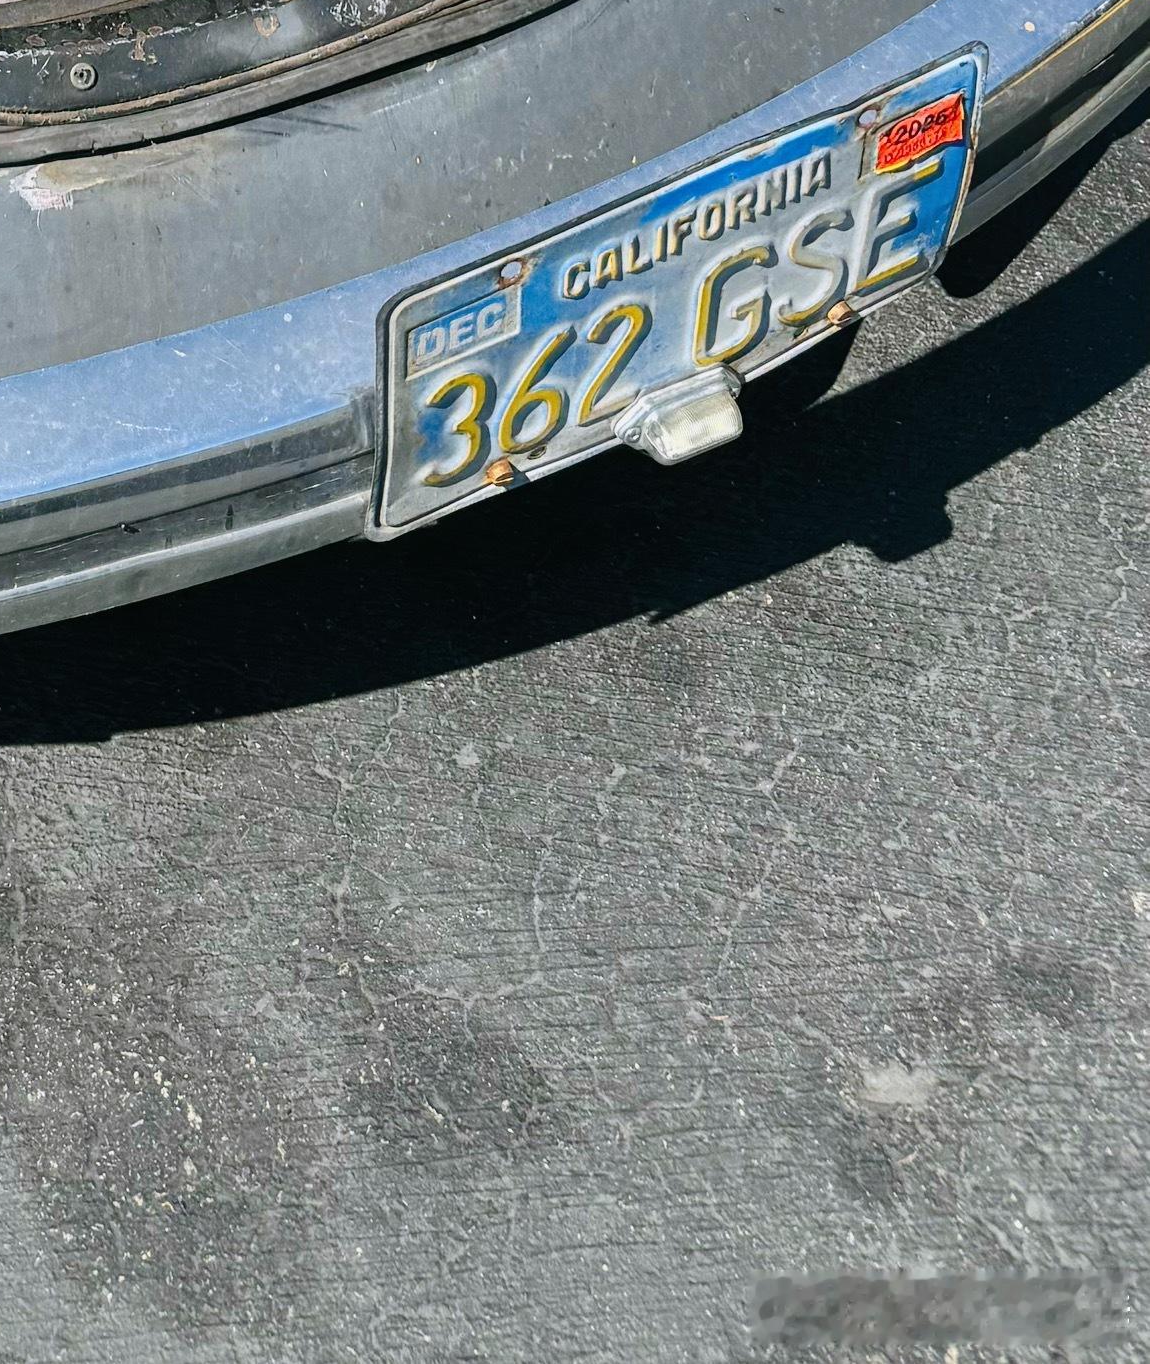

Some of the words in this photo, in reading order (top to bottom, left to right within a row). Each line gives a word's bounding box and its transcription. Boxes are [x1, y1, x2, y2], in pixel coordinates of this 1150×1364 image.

[562, 150, 832, 300] CALIFORNIA
[415, 305, 503, 360] DEC
[424, 303, 652, 487] 362
[694, 161, 940, 368] GSE
